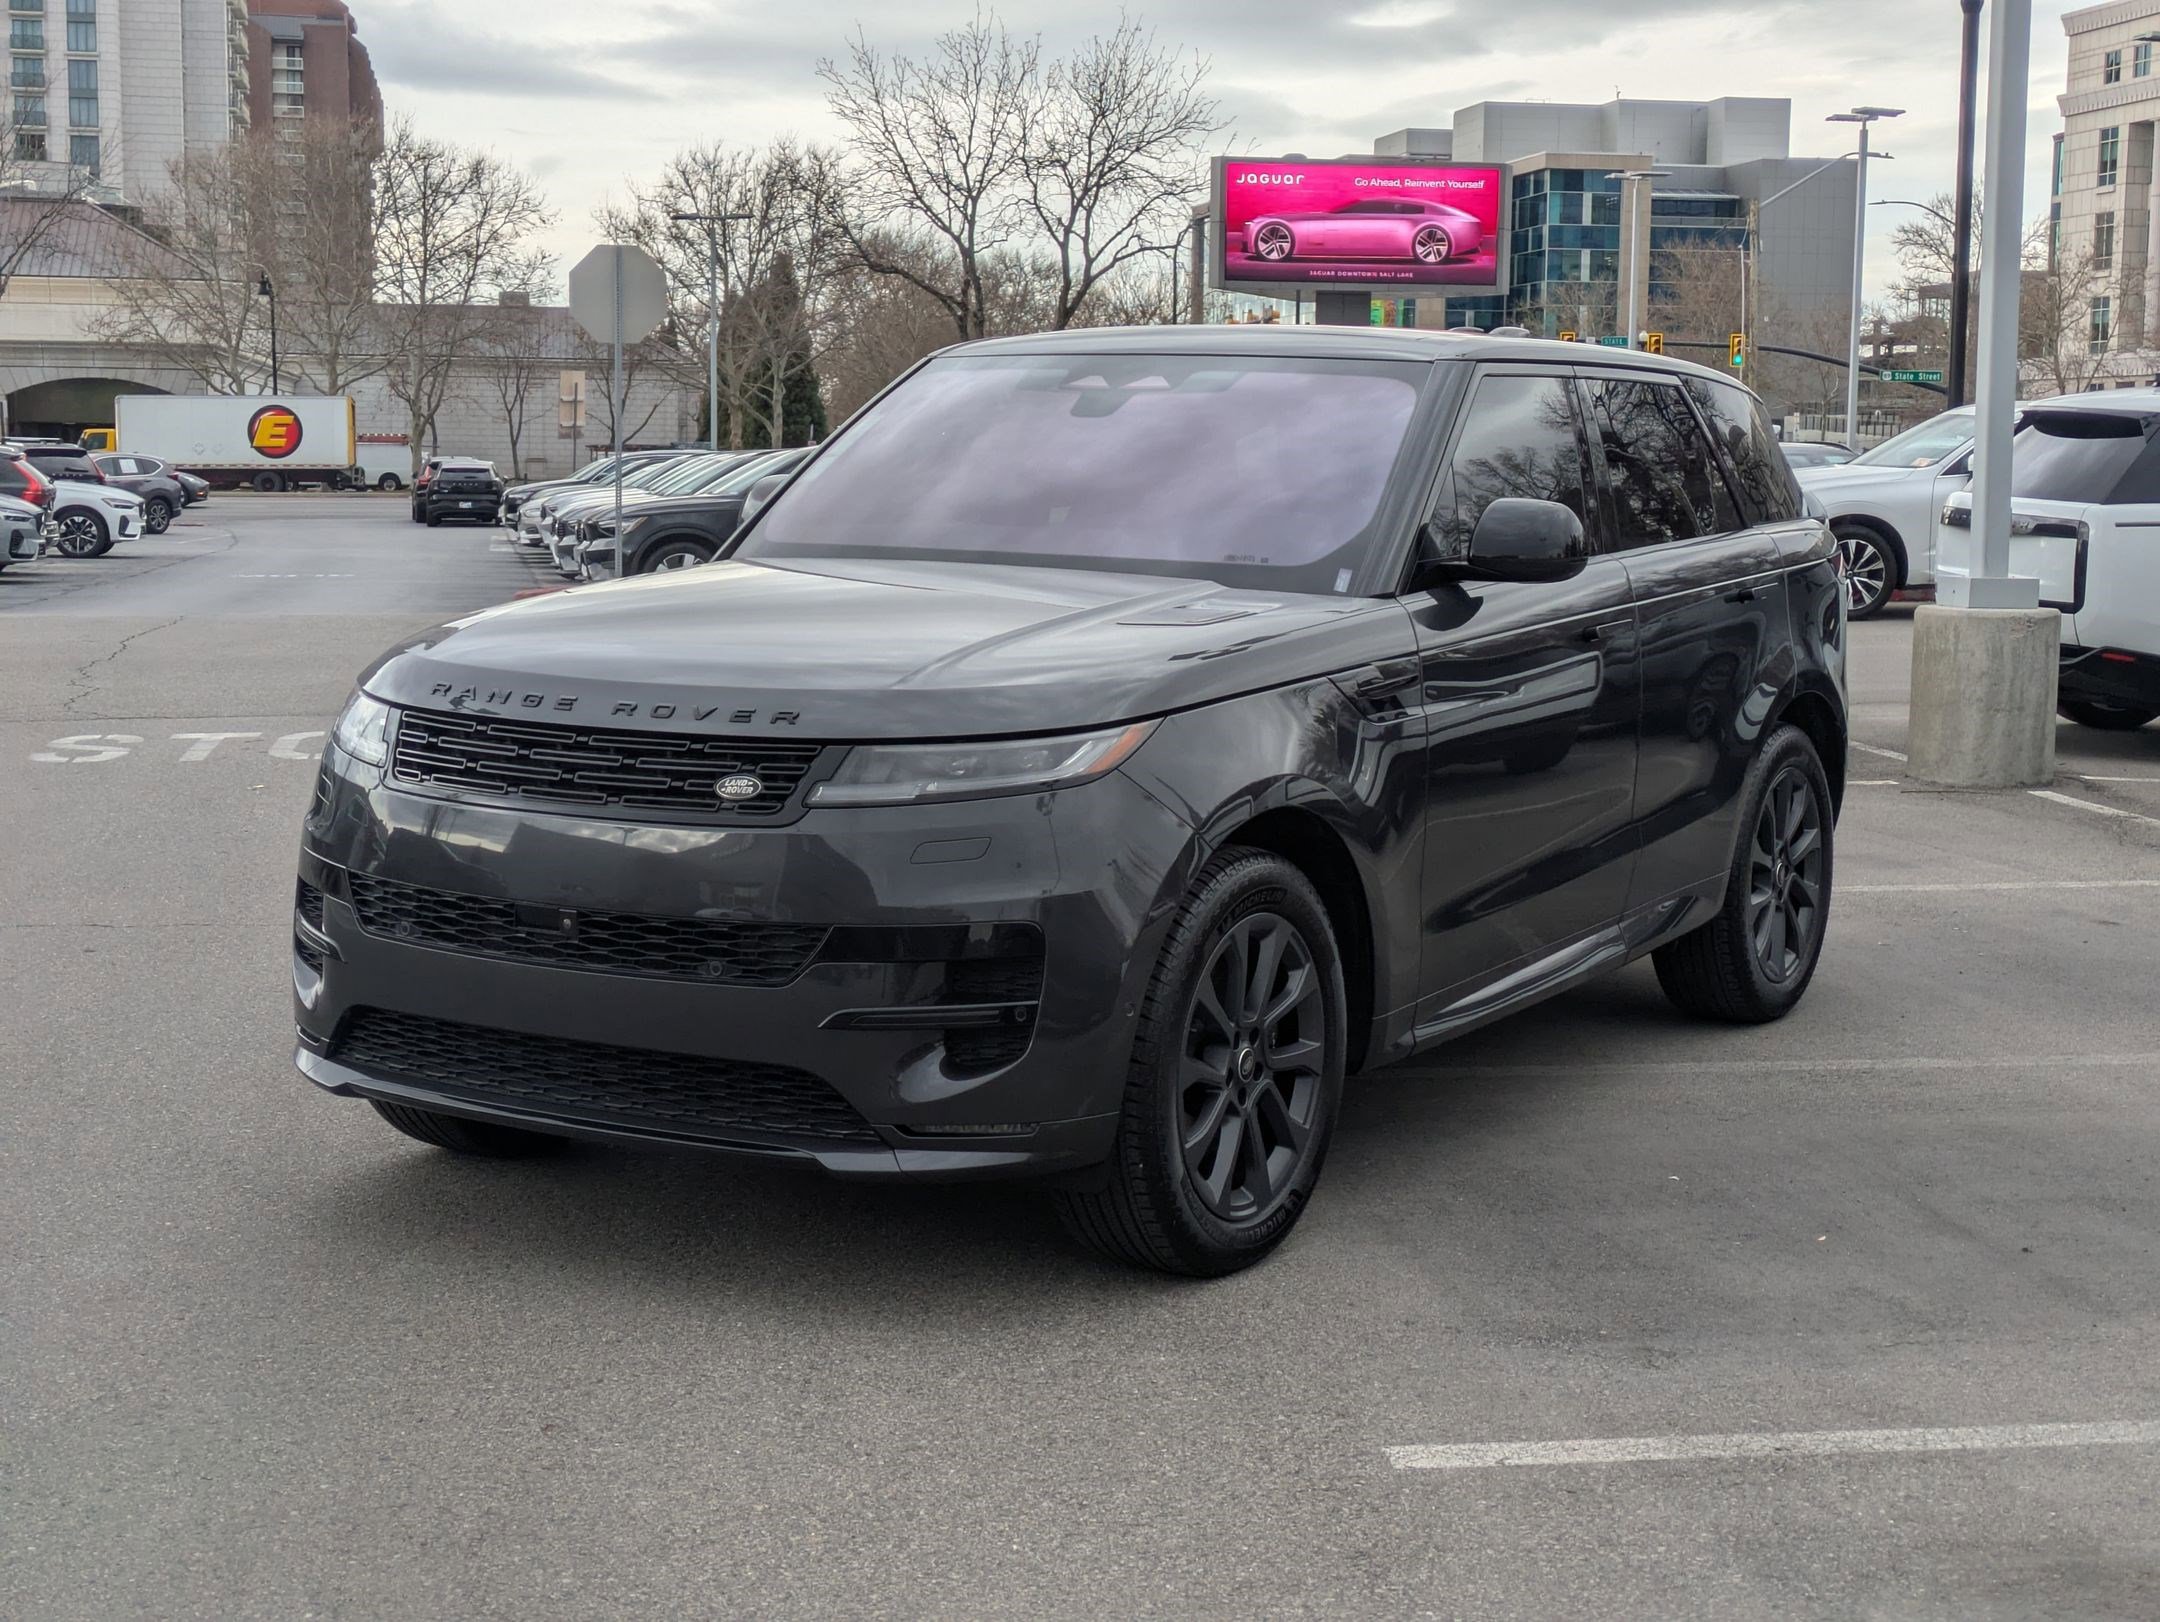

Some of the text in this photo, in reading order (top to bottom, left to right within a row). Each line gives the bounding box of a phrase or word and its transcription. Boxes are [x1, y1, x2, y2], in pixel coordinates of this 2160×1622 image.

[1354, 177, 1485, 189] Go Ahead, Reinvent Yourself
[1894, 372, 1915, 380] State
[1918, 372, 1941, 381] Street
[252, 415, 295, 448] E
[431, 683, 800, 726] RANGE ROVER
